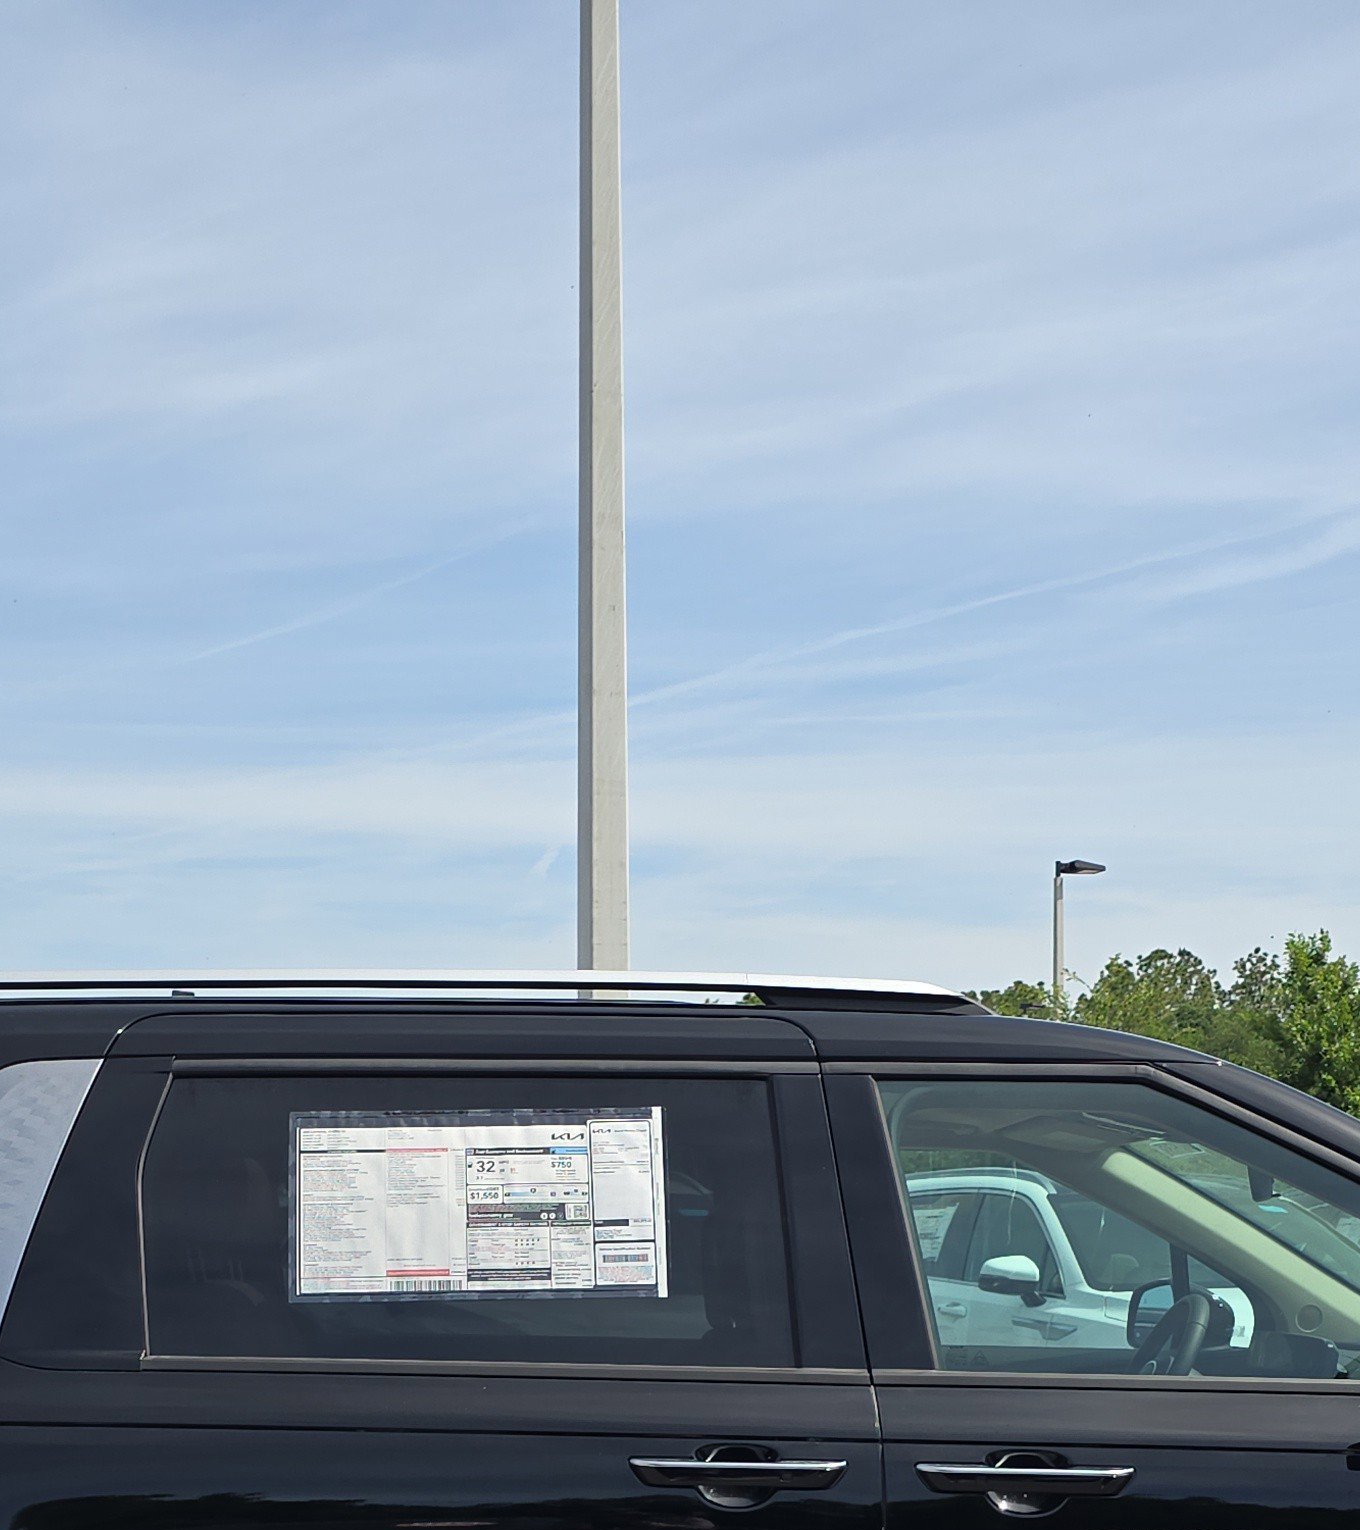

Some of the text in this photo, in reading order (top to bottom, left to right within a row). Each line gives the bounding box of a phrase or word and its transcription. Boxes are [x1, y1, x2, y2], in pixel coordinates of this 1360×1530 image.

[551, 1132, 585, 1141] KIA
[476, 1160, 496, 1173] 32
[550, 1161, 572, 1169] $750
